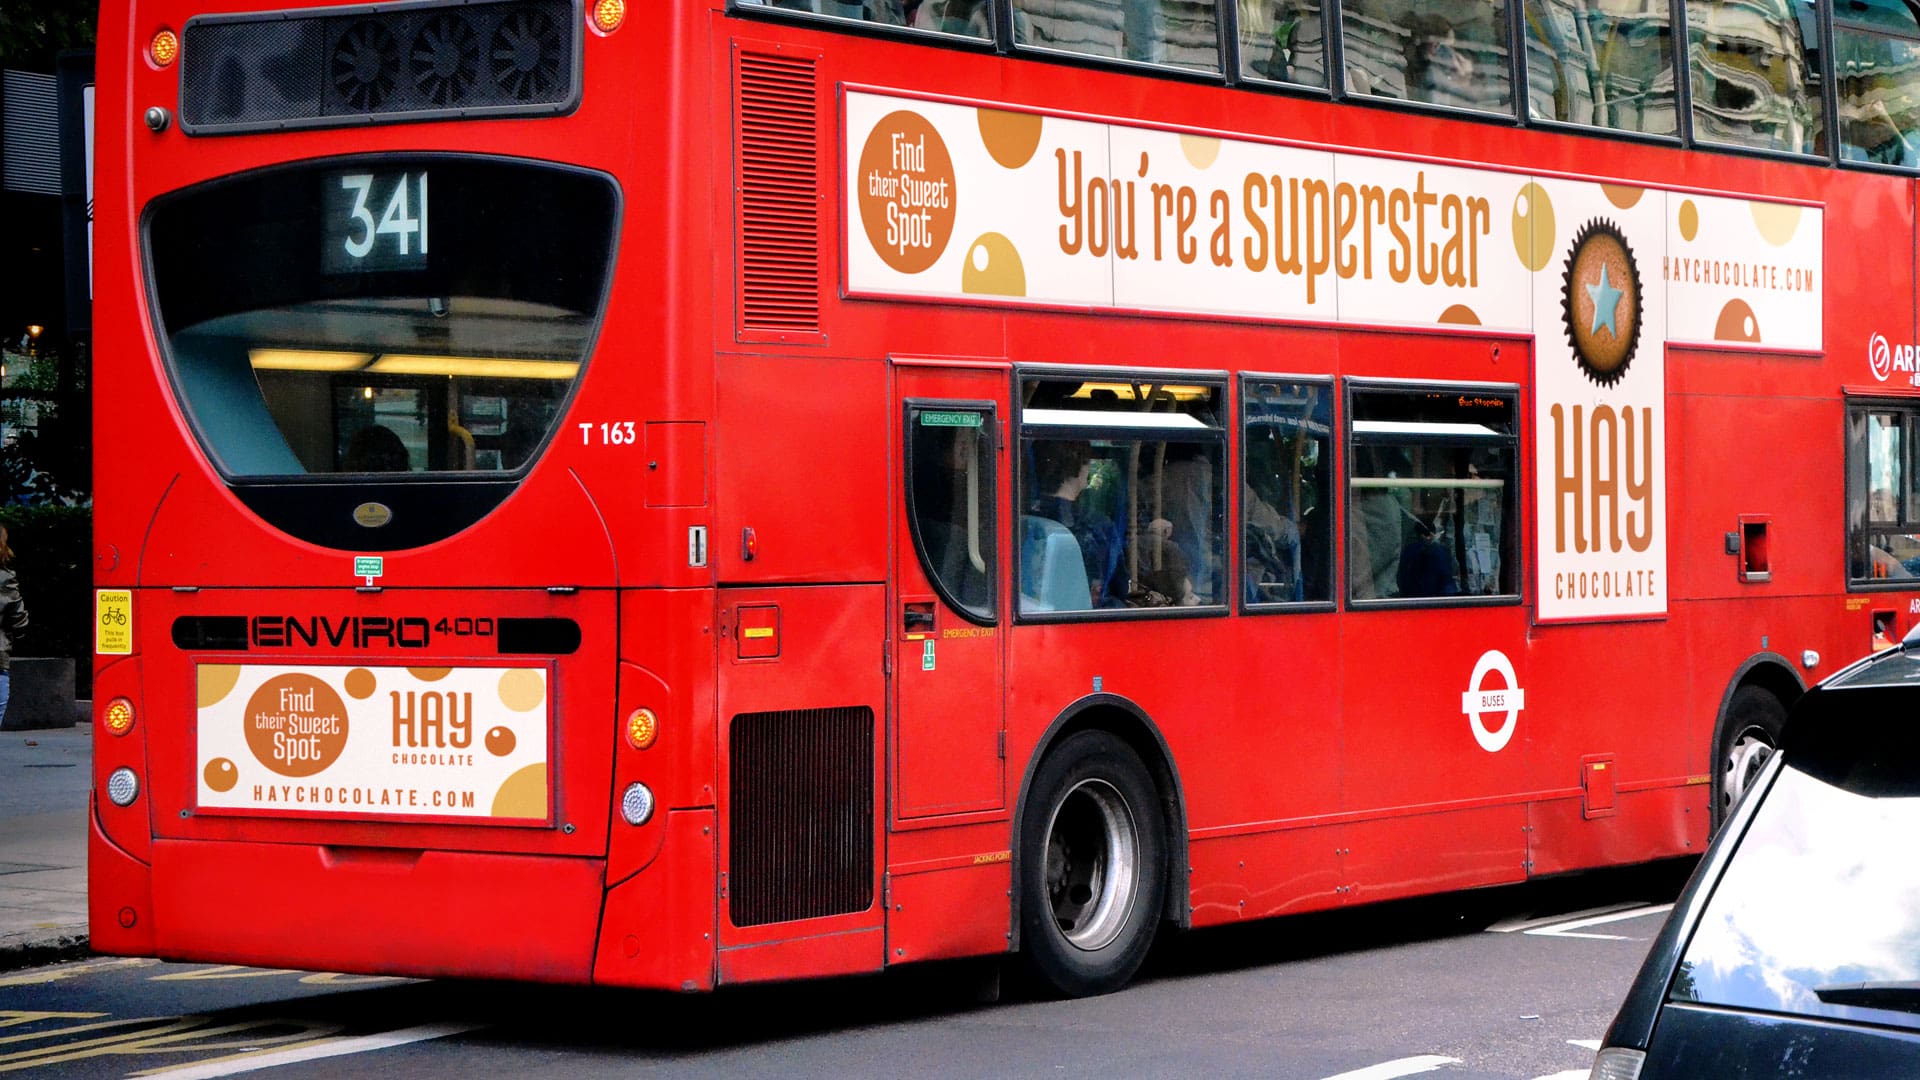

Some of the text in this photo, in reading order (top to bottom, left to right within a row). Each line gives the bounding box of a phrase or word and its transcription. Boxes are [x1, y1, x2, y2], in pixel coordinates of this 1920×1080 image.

[891, 132, 925, 173] Find
[868, 170, 949, 209] their Sweet
[342, 171, 428, 258] 341
[1054, 147, 1198, 265] You're
[1209, 188, 1233, 268] a
[887, 201, 932, 256] Spot
[1663, 255, 1814, 293] HAYCHOCOLATE.COM
[578, 421, 637, 446] T 163
[925, 413, 977, 425] EMERGENCY EXIT
[1550, 402, 1653, 554] HAY
[100, 594, 129, 602] Caution
[1555, 570, 1655, 600] CHOCOLATE
[251, 616, 494, 649] ENVIRO 400
[943, 627, 995, 638] EMERGENCY EXIT
[280, 687, 315, 712] Find
[1481, 694, 1505, 708] BUSES
[255, 711, 340, 735] their Sweet
[389, 690, 473, 749] HAY
[273, 731, 321, 767] Spot
[392, 752, 474, 767] CHOCOLATE
[253, 784, 475, 808] HAYCHOCOLATE.COM
